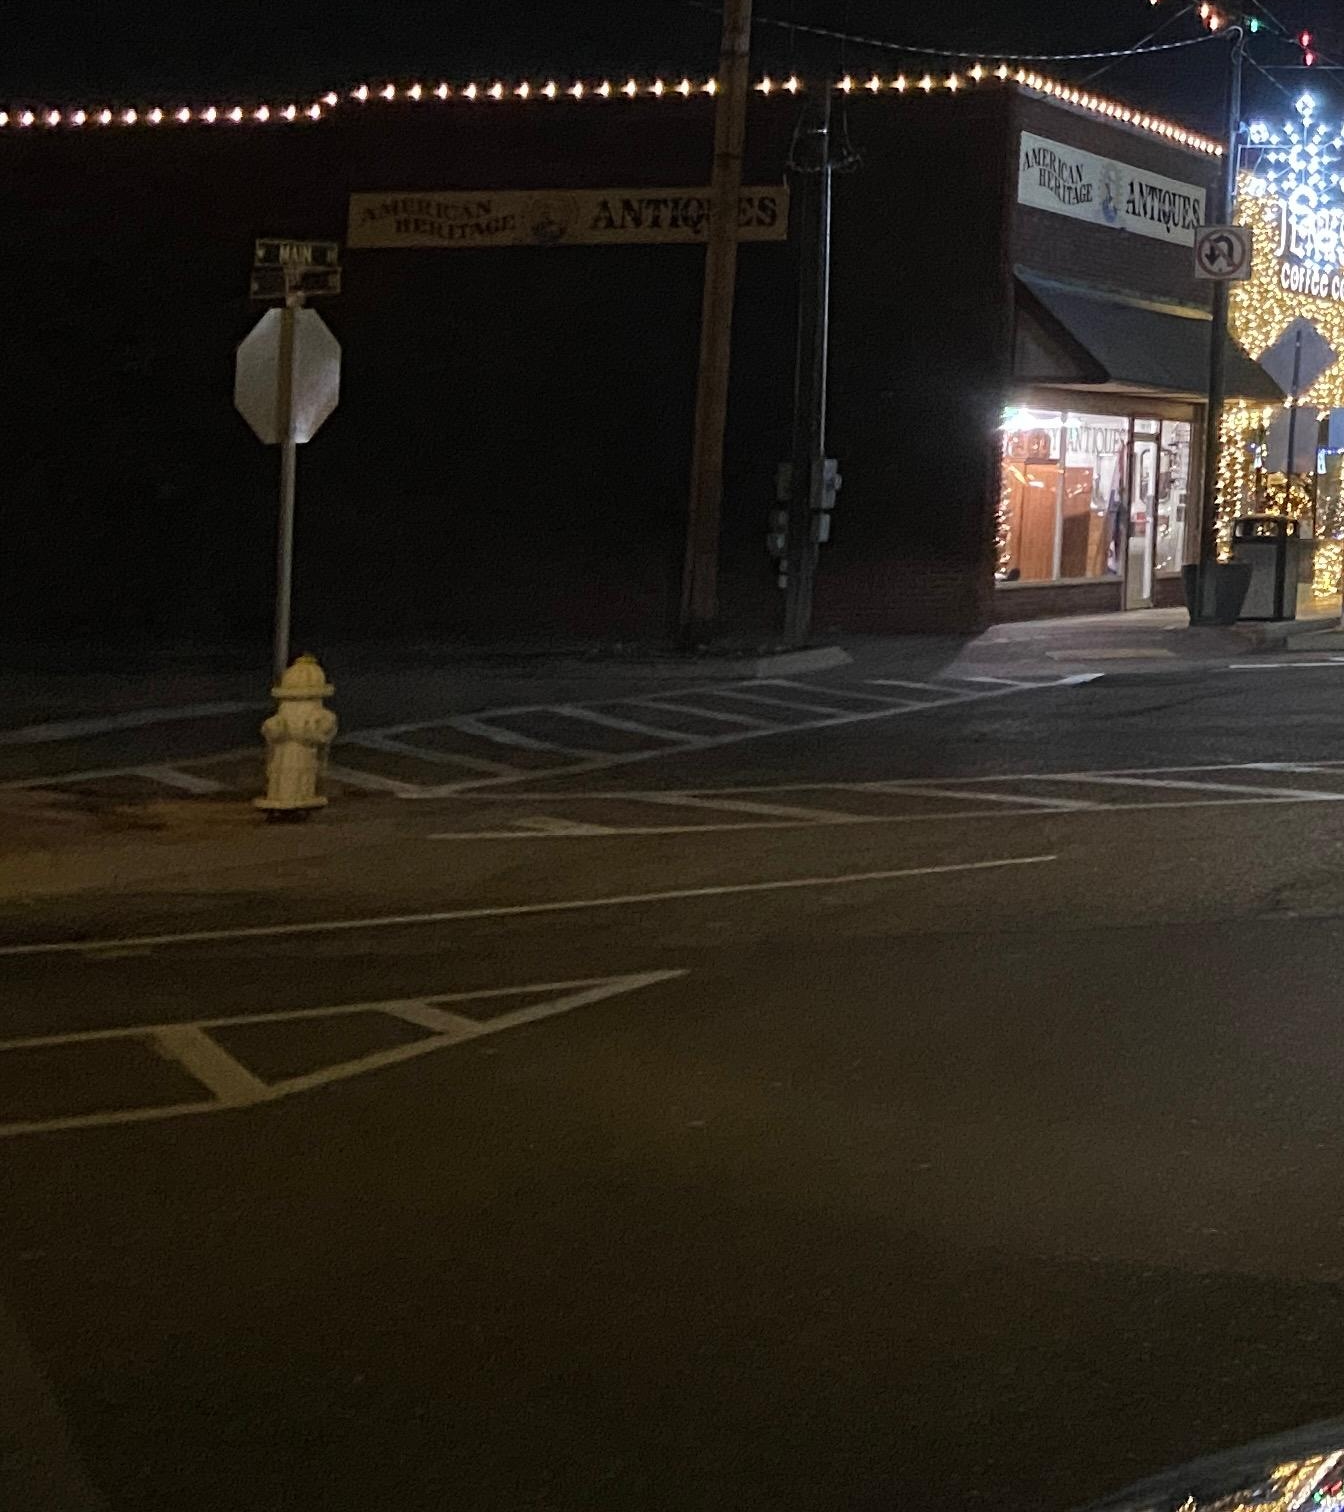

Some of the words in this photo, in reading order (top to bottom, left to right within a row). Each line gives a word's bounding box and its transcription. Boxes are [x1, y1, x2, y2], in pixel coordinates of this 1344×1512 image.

[1023, 147, 1083, 185] AMERICAN
[1039, 169, 1093, 205] HERITAGE
[362, 198, 491, 222] AMERICAN
[590, 196, 777, 234] ANTIQES
[1126, 180, 1201, 233] ANTIQUES
[395, 215, 515, 239] HERITAGE
